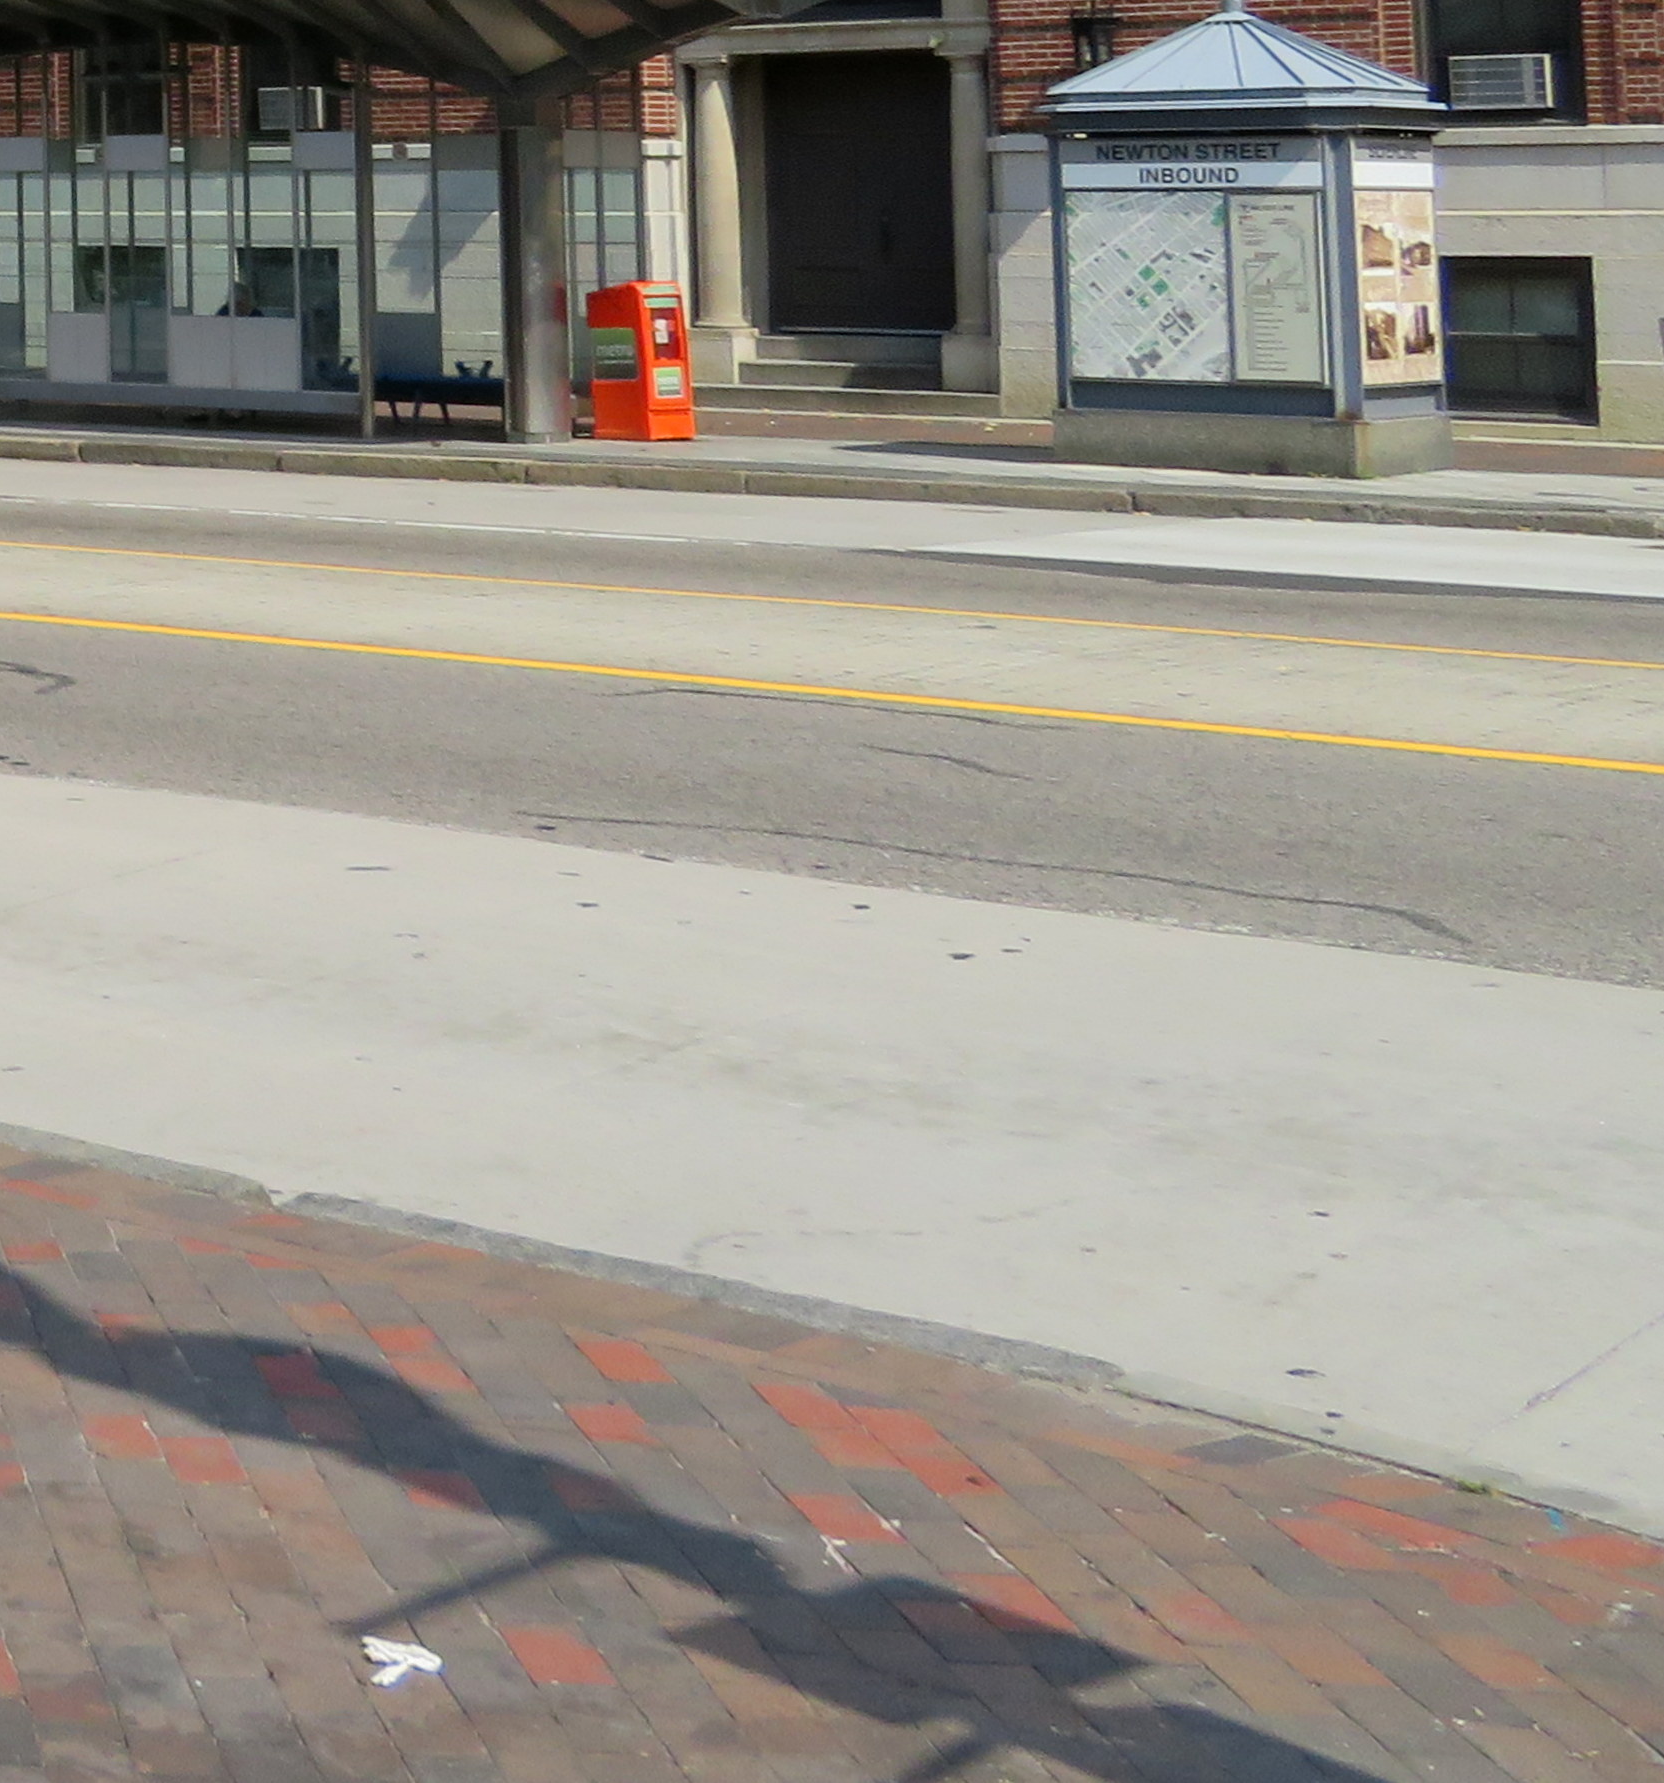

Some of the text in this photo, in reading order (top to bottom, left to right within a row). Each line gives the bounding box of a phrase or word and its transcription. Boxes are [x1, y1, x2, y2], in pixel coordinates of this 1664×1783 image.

[1096, 142, 1281, 161] NEWTON STREET
[1139, 167, 1239, 184] INBOUND
